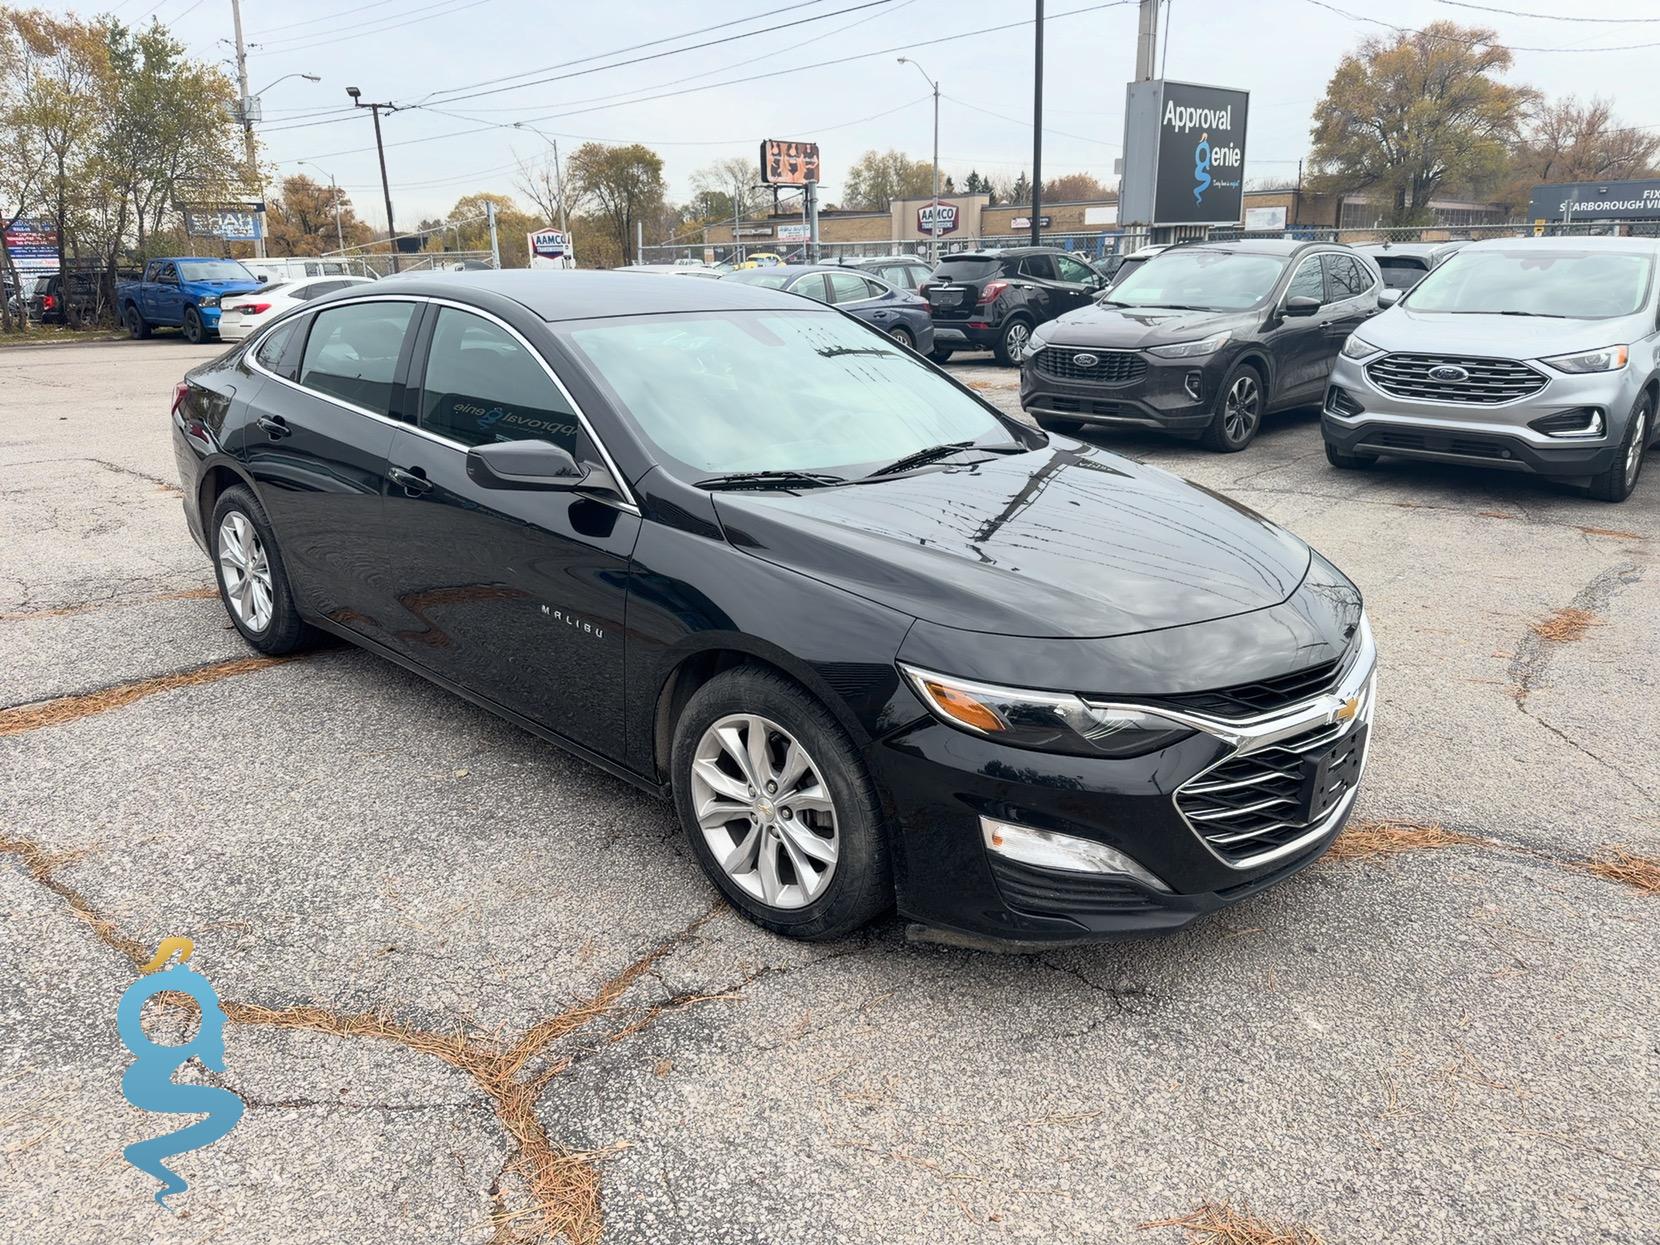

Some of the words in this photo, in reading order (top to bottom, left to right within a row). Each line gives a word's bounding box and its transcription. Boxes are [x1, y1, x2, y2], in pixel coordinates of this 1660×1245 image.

[1163, 100, 1231, 133] Approval
[1194, 140, 1240, 188] genie
[1643, 189, 1660, 199] FIX
[1559, 200, 1644, 212] SARBOROUGH
[536, 235, 567, 245] AAMCO
[541, 604, 603, 638] MALIBU
